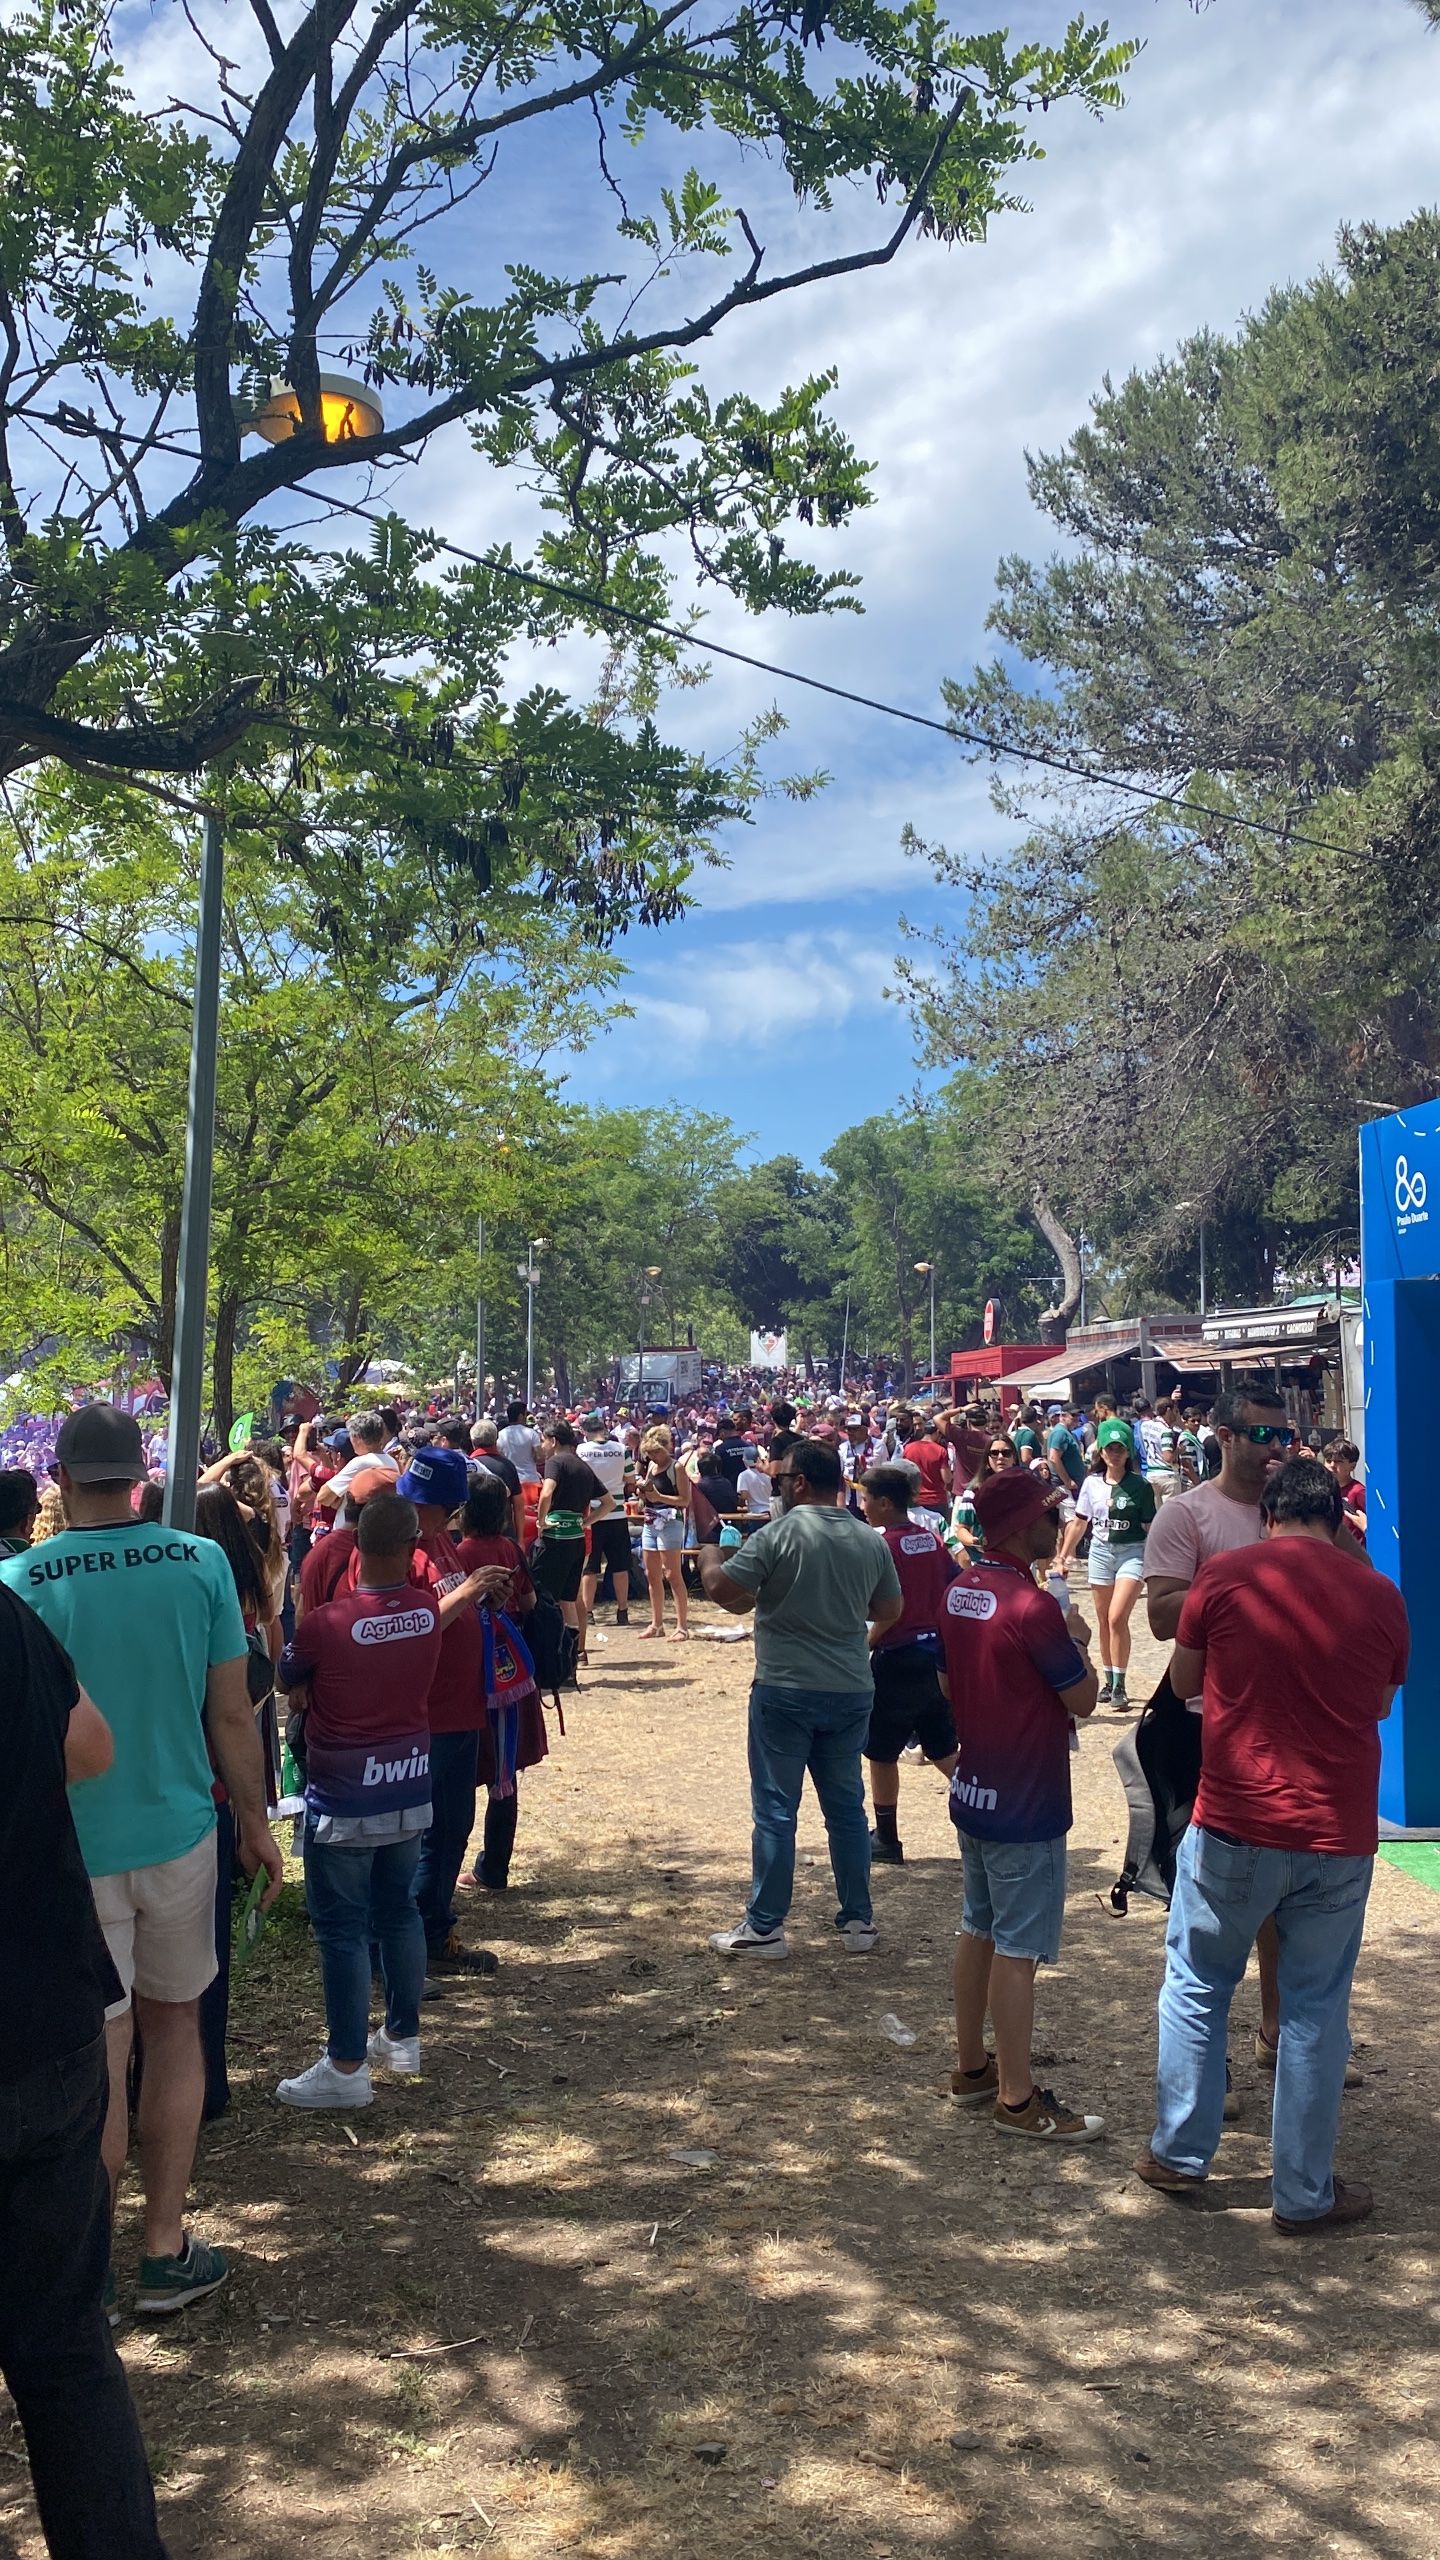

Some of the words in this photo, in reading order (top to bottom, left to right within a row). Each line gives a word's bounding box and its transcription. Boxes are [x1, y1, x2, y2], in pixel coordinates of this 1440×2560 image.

[603, 1450, 623, 1458] BOCK
[28, 1551, 118, 1586] SUPER
[123, 1542, 200, 1568] BOCK
[361, 1613, 431, 1640] Agriloja
[362, 1746, 429, 1787] bwin
